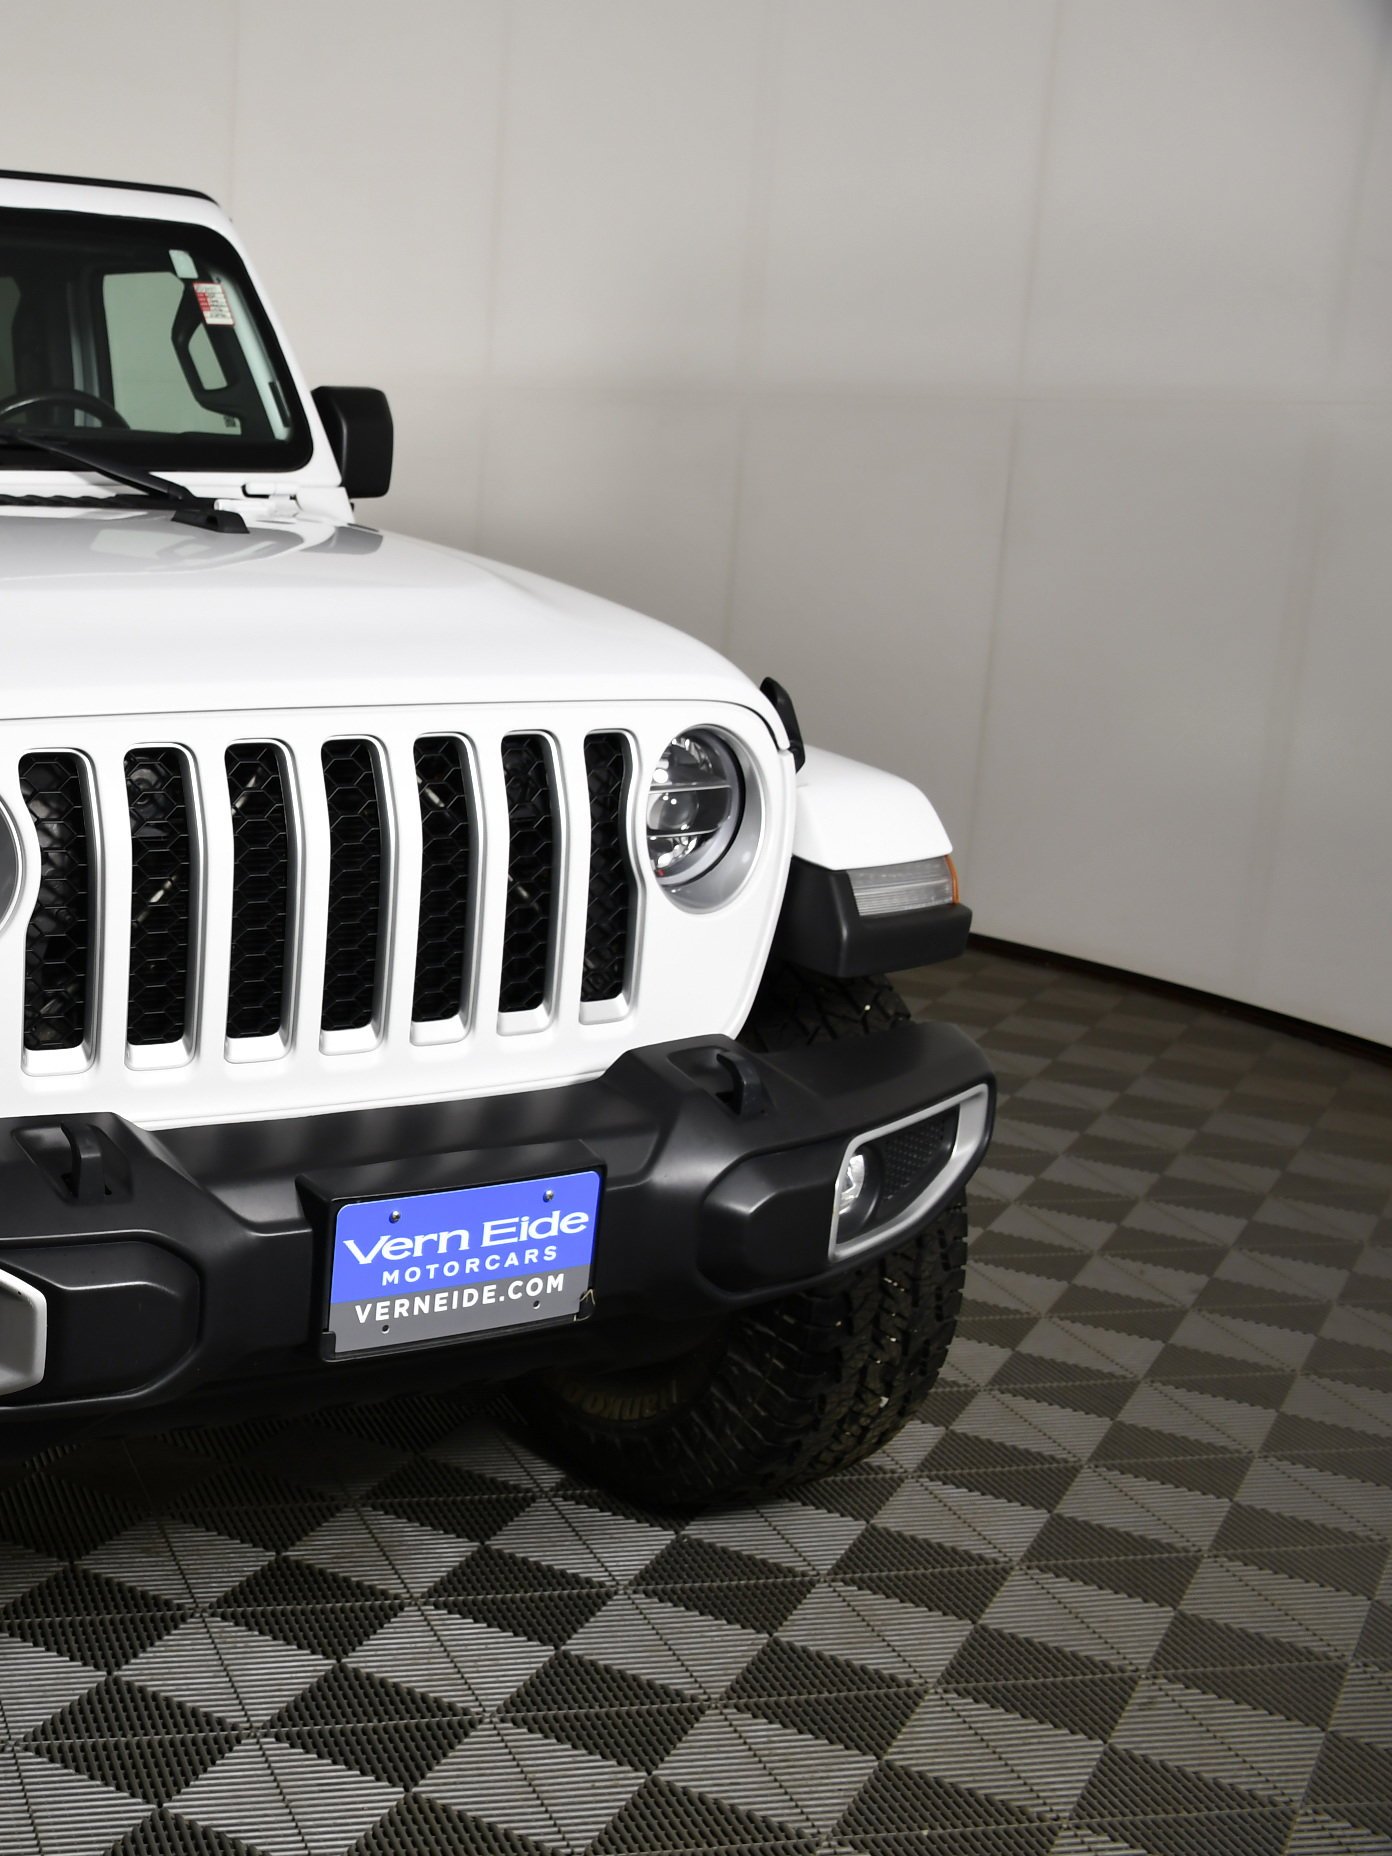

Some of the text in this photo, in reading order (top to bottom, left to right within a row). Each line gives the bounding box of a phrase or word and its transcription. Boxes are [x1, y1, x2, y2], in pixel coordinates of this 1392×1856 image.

[342, 1209, 590, 1265] Vern Eide
[381, 1245, 558, 1286] MOTORCARS
[355, 1273, 565, 1324] VERNEIDE.COM
